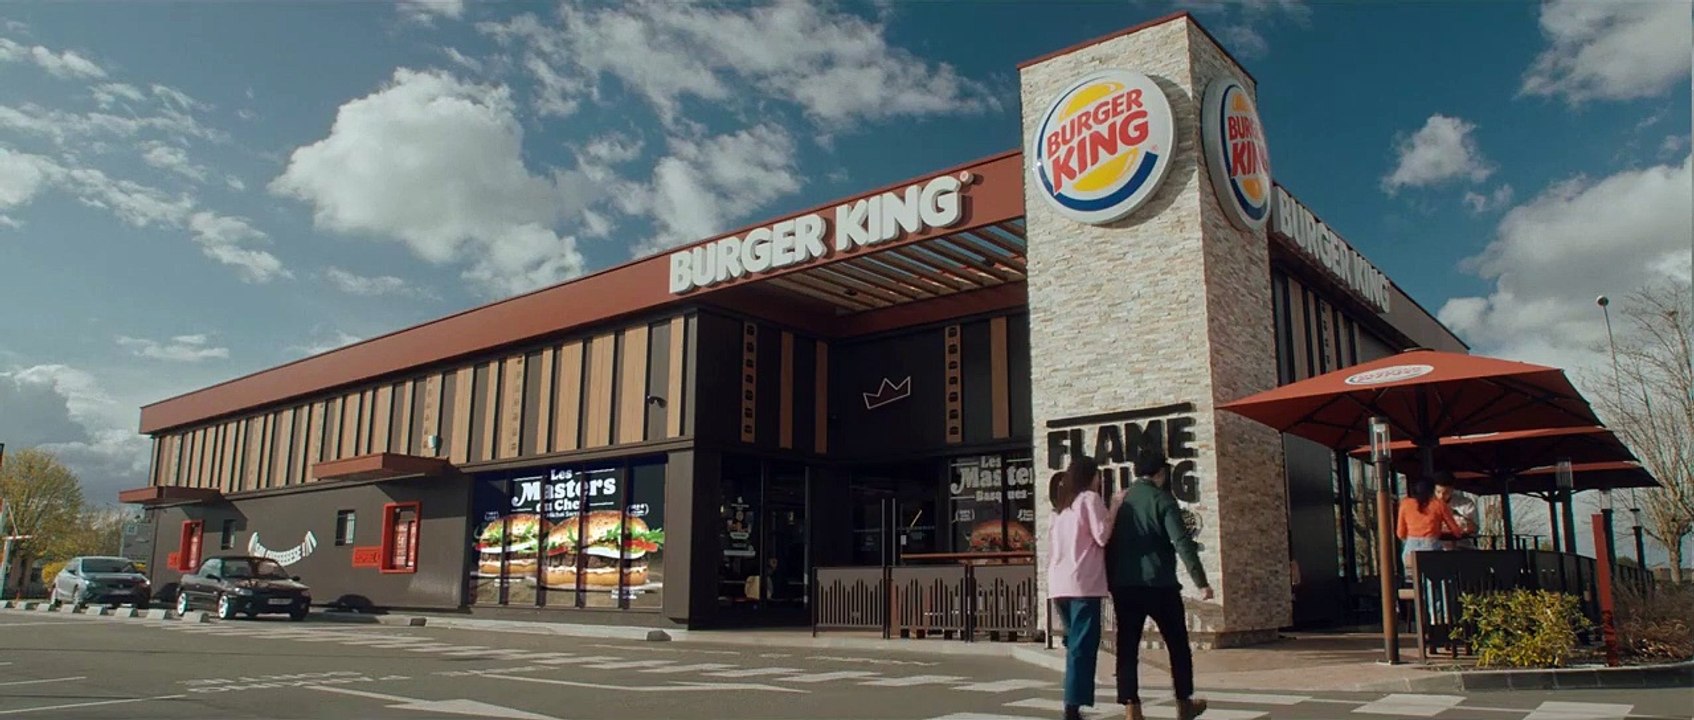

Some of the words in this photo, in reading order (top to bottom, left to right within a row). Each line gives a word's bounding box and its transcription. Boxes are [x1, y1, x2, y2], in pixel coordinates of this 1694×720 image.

[1046, 88, 1143, 160] BURGER
[1052, 110, 1148, 193] KING
[669, 213, 826, 294] BURGER
[835, 175, 963, 252] KING
[1273, 185, 1351, 284] BURGER
[1349, 250, 1390, 313] KING
[550, 468, 573, 481] Les
[1047, 416, 1197, 470] FLAME
[511, 477, 616, 507] Masters
[554, 498, 587, 512] Che
